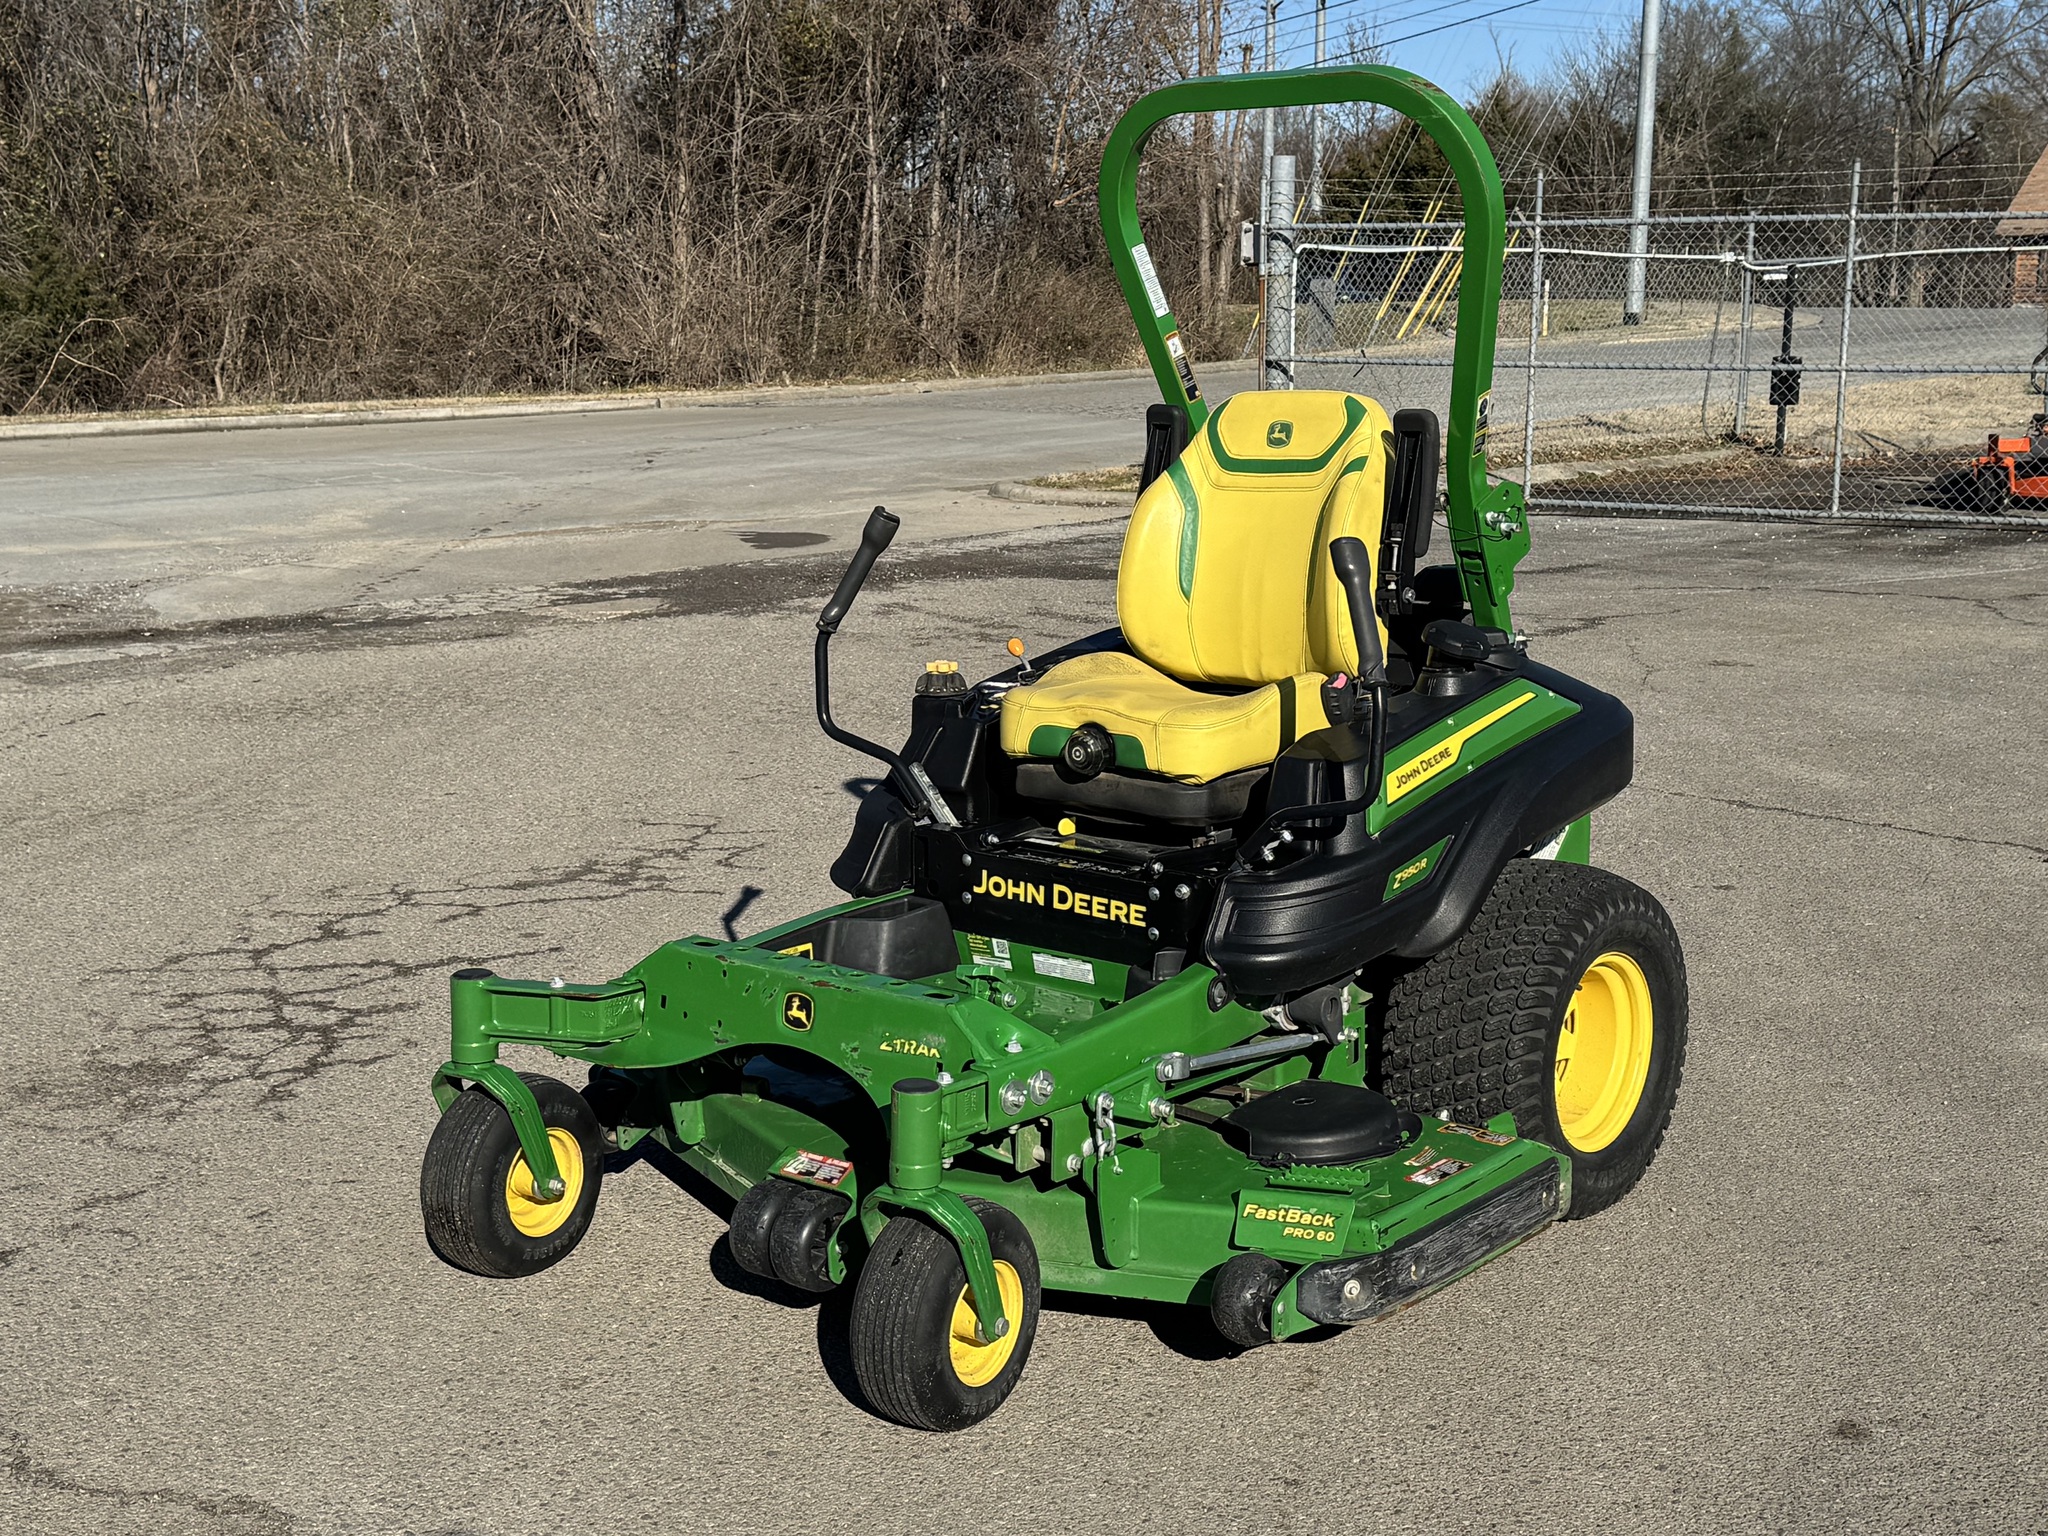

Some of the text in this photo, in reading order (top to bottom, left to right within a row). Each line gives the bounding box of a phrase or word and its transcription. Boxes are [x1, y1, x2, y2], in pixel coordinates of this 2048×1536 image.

[1395, 747, 1453, 789] JOHN DEERE
[1392, 857, 1428, 890] Z950R
[973, 869, 1147, 927] JOHN DEERE
[1242, 1203, 1336, 1228] FastBack
[1282, 1226, 1335, 1242] PRO 60
